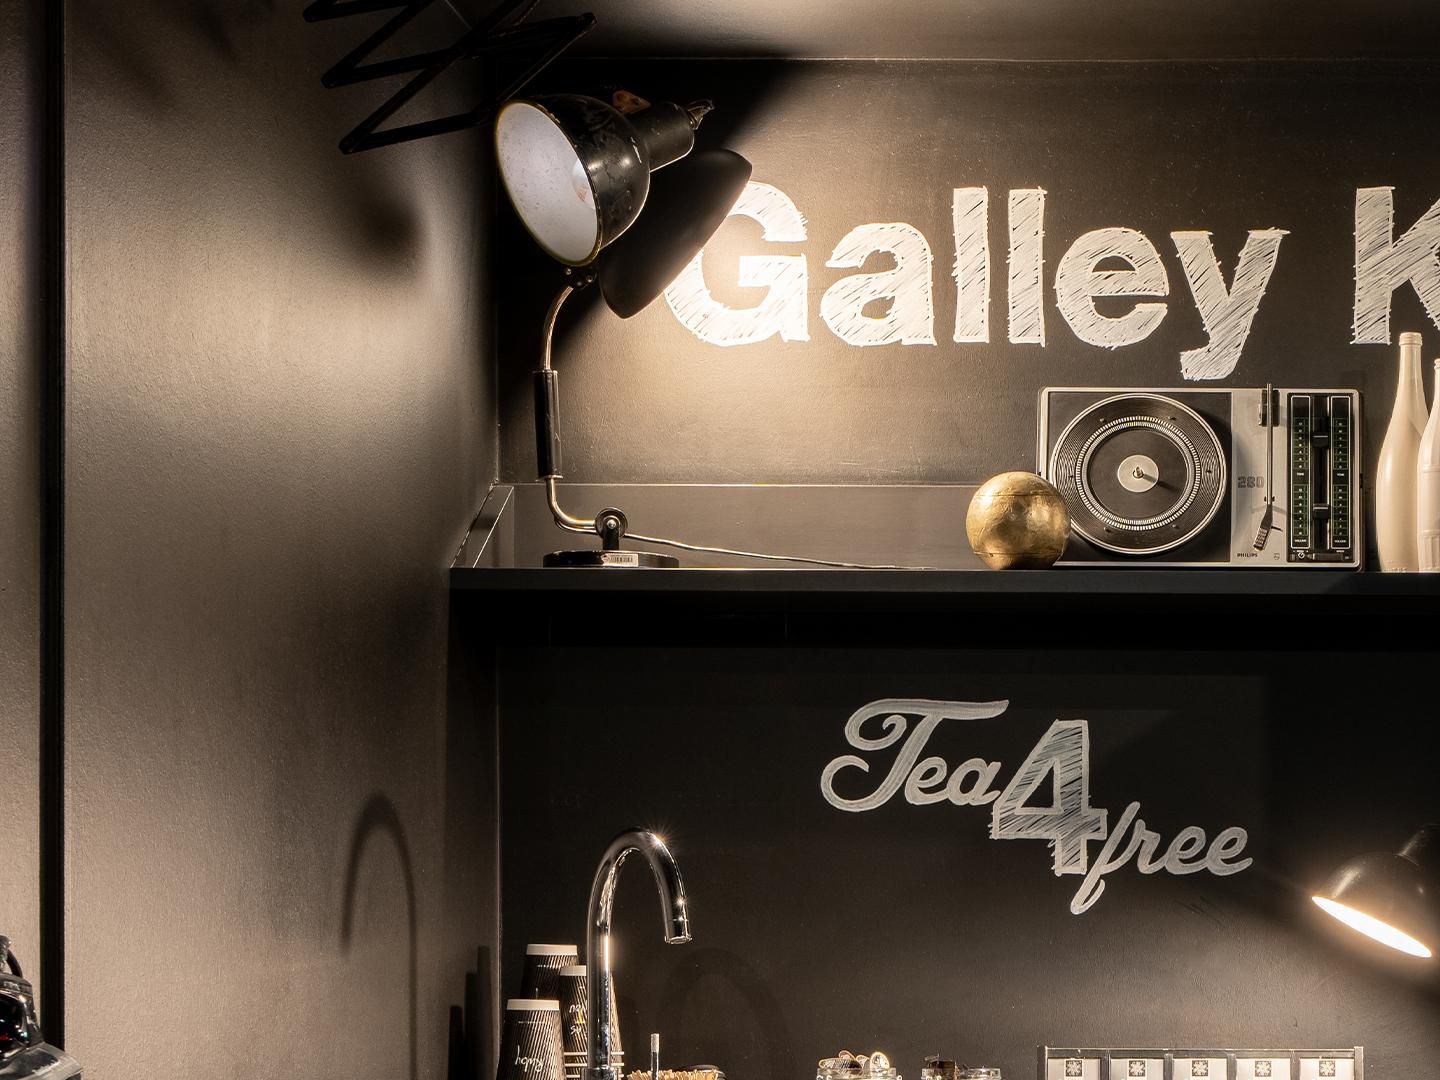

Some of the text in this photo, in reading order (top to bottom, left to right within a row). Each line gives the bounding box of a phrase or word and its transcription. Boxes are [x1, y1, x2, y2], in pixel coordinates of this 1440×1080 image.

[663, 181, 1290, 381] Galley
[1237, 476, 1265, 489] 280
[820, 698, 1253, 915] Tea 4 free
[514, 1044, 545, 1072] Ruby
